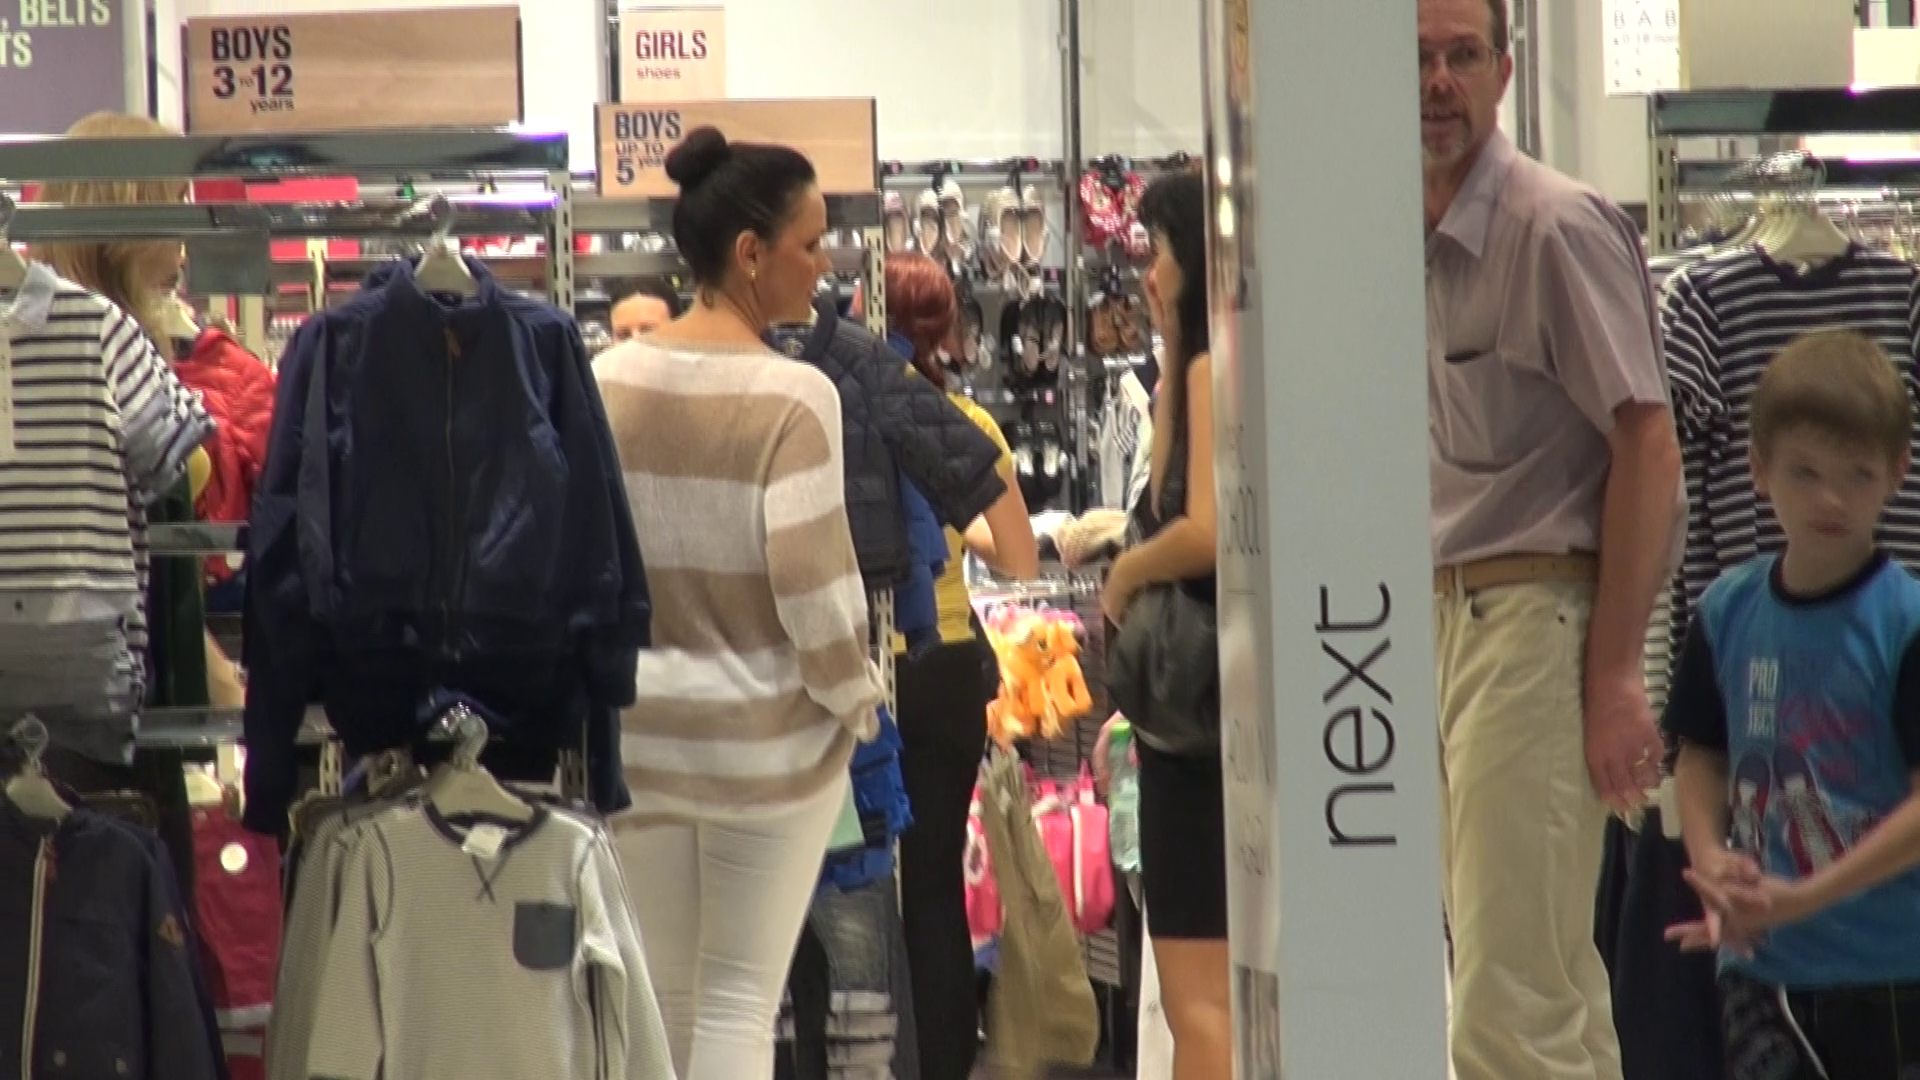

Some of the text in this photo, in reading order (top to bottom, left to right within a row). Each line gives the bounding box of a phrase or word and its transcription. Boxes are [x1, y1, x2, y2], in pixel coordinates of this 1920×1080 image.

[20, 0, 110, 27] BELTS
[211, 25, 292, 61] BOYS
[635, 29, 707, 60] GIRLS
[212, 65, 236, 98] 3
[250, 64, 294, 97] 12
[636, 66, 681, 80] shoes
[250, 98, 295, 115] years
[615, 111, 681, 140] BOYS
[615, 141, 664, 155] UP TO
[615, 156, 635, 185] 5
[1749, 658, 1779, 699] PRO
[1314, 581, 1397, 848] next
